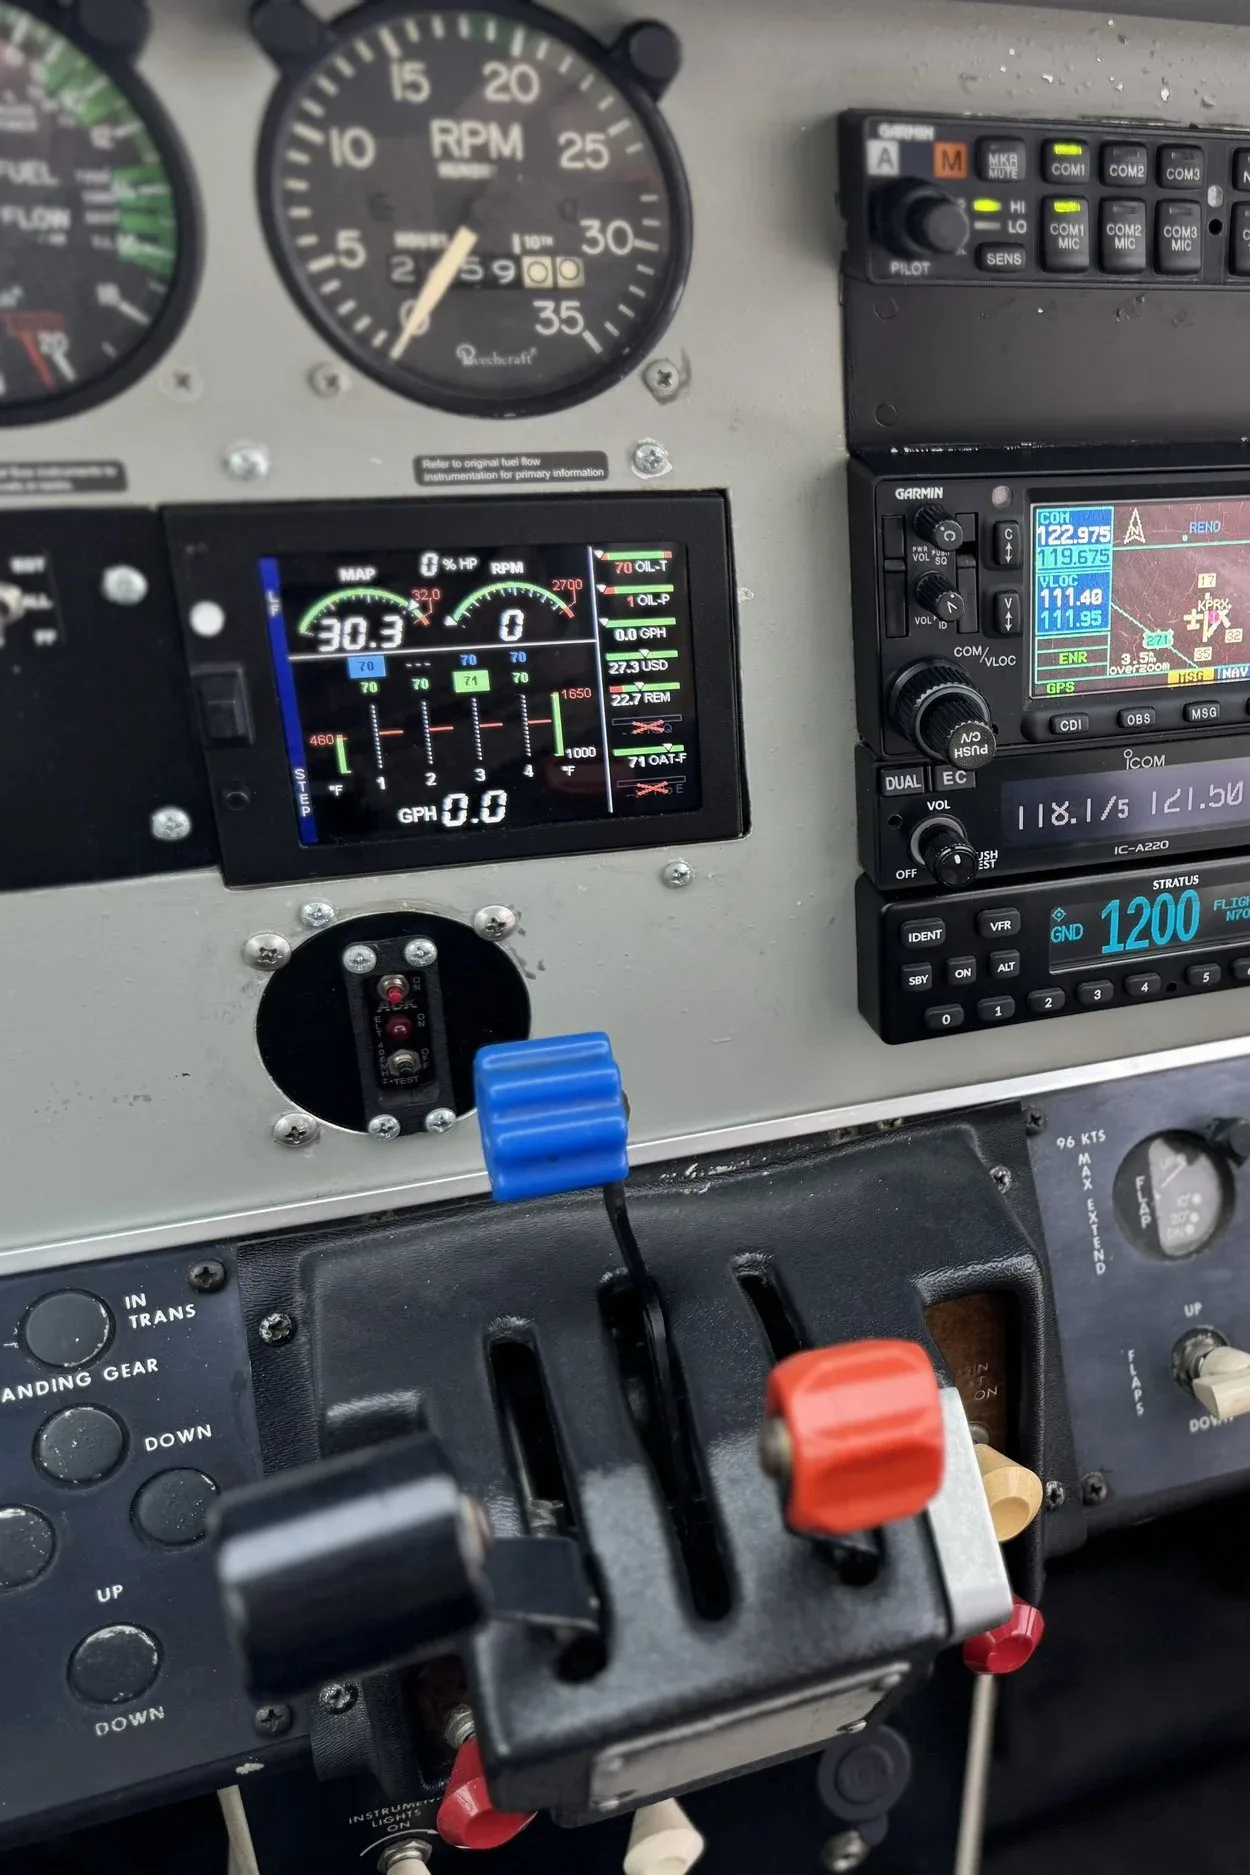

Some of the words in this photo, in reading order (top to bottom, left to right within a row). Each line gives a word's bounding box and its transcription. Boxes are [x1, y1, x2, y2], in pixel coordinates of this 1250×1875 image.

[390, 61, 431, 103] 15
[481, 61, 540, 103] 20
[429, 118, 525, 161] RPM
[330, 126, 376, 169] 10
[557, 131, 611, 171] 25
[988, 153, 1019, 167] MKR
[988, 167, 1019, 180] MUTE
[1051, 164, 1086, 176] COM1
[1109, 165, 1145, 177] COM2
[1166, 168, 1201, 181] COM3
[1010, 200, 1026, 215] HI
[1008, 220, 1027, 235] LO
[1050, 223, 1086, 237] COM1
[1106, 223, 1142, 237] COM2
[1163, 225, 1198, 239] COM3
[579, 218, 635, 256] 30
[1058, 236, 1081, 250] MIC
[1114, 236, 1136, 250] MIC
[335, 230, 366, 268] 5
[1171, 238, 1192, 253] MIC
[986, 253, 1022, 267] SENS
[890, 261, 931, 276] PILOT
[532, 300, 585, 336] 35
[421, 458, 450, 469] Refer
[451, 458, 463, 469] to
[464, 457, 499, 470] original
[501, 456, 519, 467] fuel
[521, 456, 541, 467] flow
[423, 470, 499, 482] instrumentation
[500, 469, 514, 480] for
[515, 469, 551, 481] primary
[552, 467, 605, 479] information
[894, 487, 944, 500] GARMIN
[1039, 511, 1070, 524] COM
[1189, 520, 1222, 534] RENO
[1036, 525, 1111, 545] 122.975
[459, 557, 479, 571] HP
[912, 553, 931, 562] VOL
[1037, 547, 1110, 568] 119.675
[338, 566, 377, 582] MAP
[490, 561, 525, 575] RPM
[614, 561, 633, 575] 70
[634, 559, 669, 574] OIL-T
[552, 579, 584, 591] 2700
[1039, 575, 1079, 587] VLOC
[636, 593, 671, 607] OIL-P
[1040, 588, 1103, 608] 111.40
[499, 608, 526, 642] 0
[1040, 609, 1103, 629] 111.95
[316, 613, 404, 652] 30.3
[614, 627, 639, 642] 0.0
[639, 626, 668, 640] GPH
[1058, 651, 1088, 665] ENR
[608, 660, 641, 675] 27.3
[641, 658, 669, 673] USD
[1109, 663, 1170, 675] overzoom
[1222, 667, 1249, 680] NAV
[561, 687, 593, 700] 1650
[1046, 681, 1075, 694] GPS
[610, 692, 642, 707] 22.7
[643, 691, 672, 705] REM
[1126, 713, 1151, 726] OBS
[1191, 707, 1218, 719] MSG
[1060, 719, 1082, 731] CDI
[308, 734, 335, 747] 460
[565, 746, 597, 760] 1000
[648, 751, 688, 767] OAT-F
[953, 743, 989, 760] PUSH
[885, 775, 922, 791] DUAL
[396, 805, 438, 825] GPH
[440, 789, 509, 828] 0.0
[926, 800, 951, 812] VOL
[1114, 840, 1170, 856] IC-A220
[895, 868, 918, 881] OFF
[1152, 875, 1200, 891] STRATUS
[989, 920, 1012, 932] VFR
[1100, 887, 1200, 955] 1200
[908, 929, 943, 943] IDENT
[1050, 922, 1084, 944] GND
[954, 967, 972, 979] ON
[996, 961, 1016, 973] ALT
[908, 974, 929, 987] SBY
[1056, 1136, 1076, 1149] 96
[1080, 1129, 1107, 1146] KTS
[1077, 1152, 1094, 1191] MAX
[1135, 1175, 1153, 1230] FLAP
[1085, 1198, 1108, 1276] EXTEND
[125, 1292, 148, 1309] IN
[128, 1303, 198, 1330] TRANS
[1183, 1301, 1203, 1318] UP
[0, 1371, 93, 1403] ANDING
[103, 1358, 160, 1382] GEAR
[1127, 1349, 1145, 1416] FLAPS
[144, 1423, 213, 1452] DOWN
[96, 1583, 124, 1603] UP
[95, 1705, 167, 1738] DOWN
[371, 1808, 422, 1828] LIGHTS
[386, 1820, 412, 1832] ON
